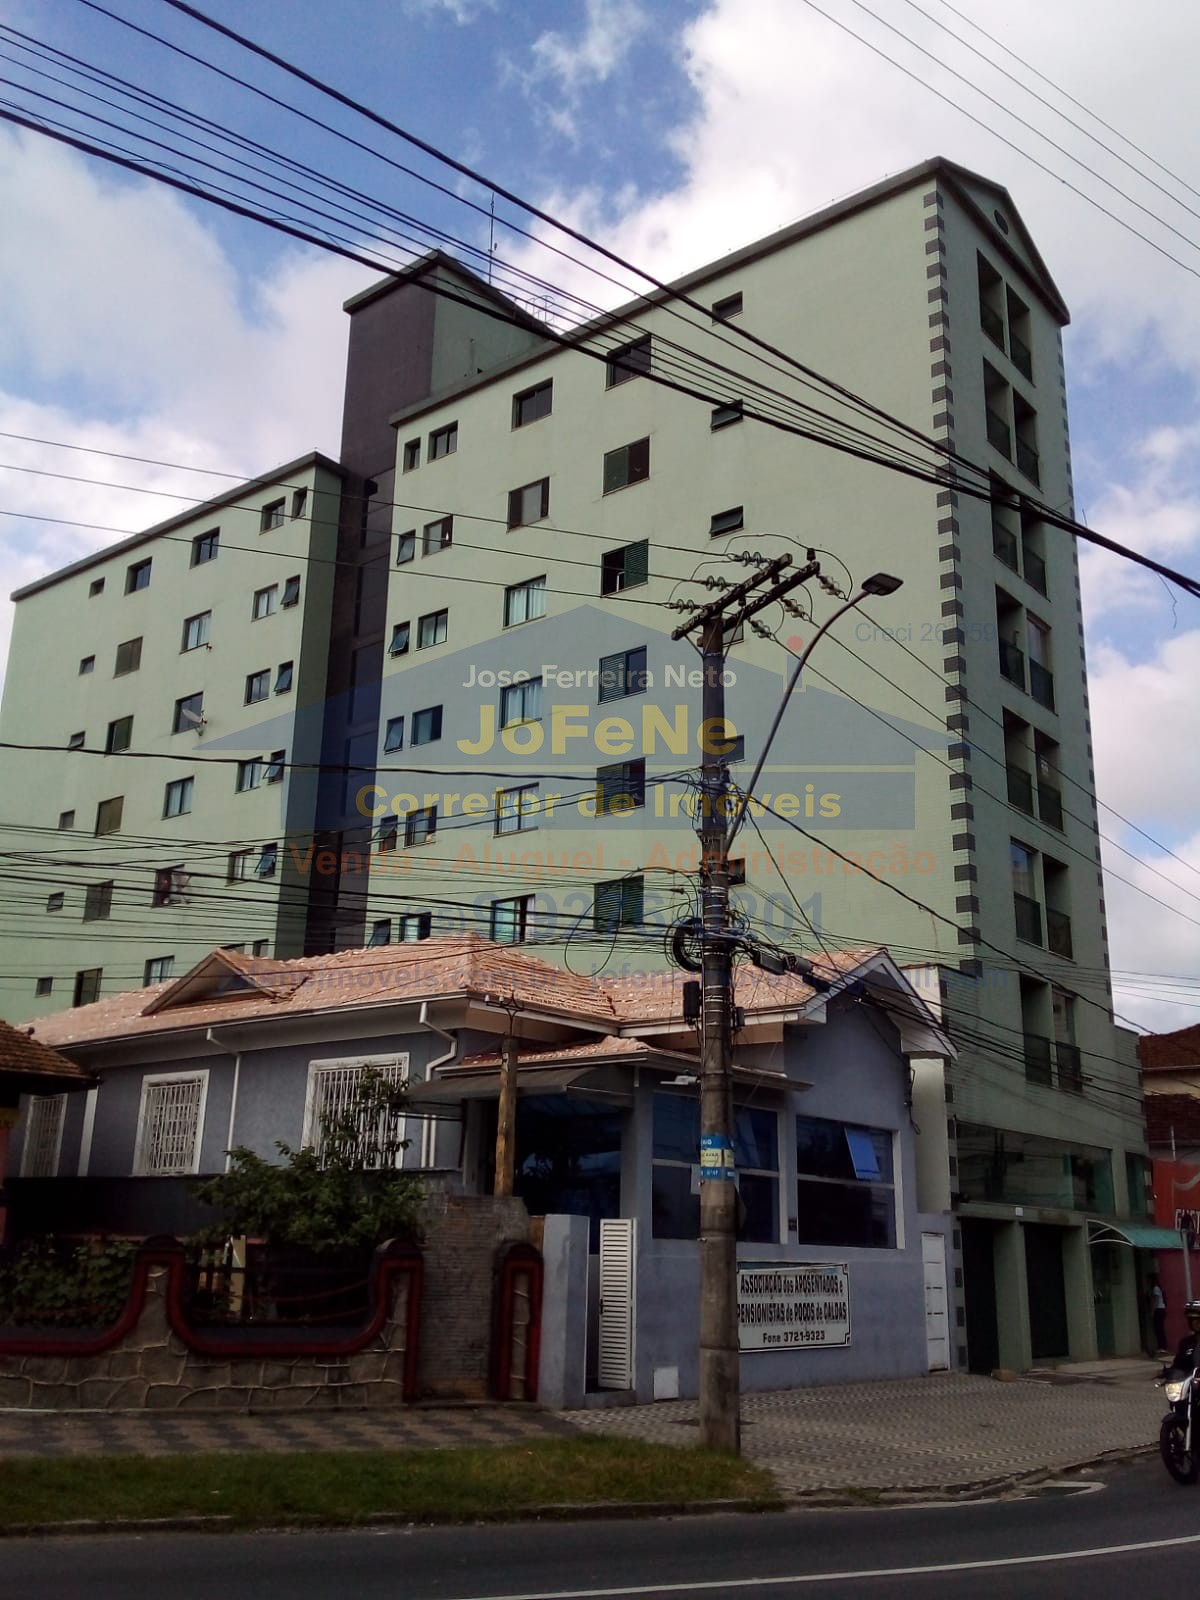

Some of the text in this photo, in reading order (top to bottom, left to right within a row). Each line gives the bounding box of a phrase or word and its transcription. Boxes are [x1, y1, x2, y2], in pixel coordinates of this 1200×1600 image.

[795, 1274, 838, 1293] APOSENTADOS
[786, 1303, 793, 1321] de
[816, 1302, 823, 1320] de
[824, 1302, 847, 1320] CALDAS
[763, 1330, 826, 1343] Fone 3721-9323
